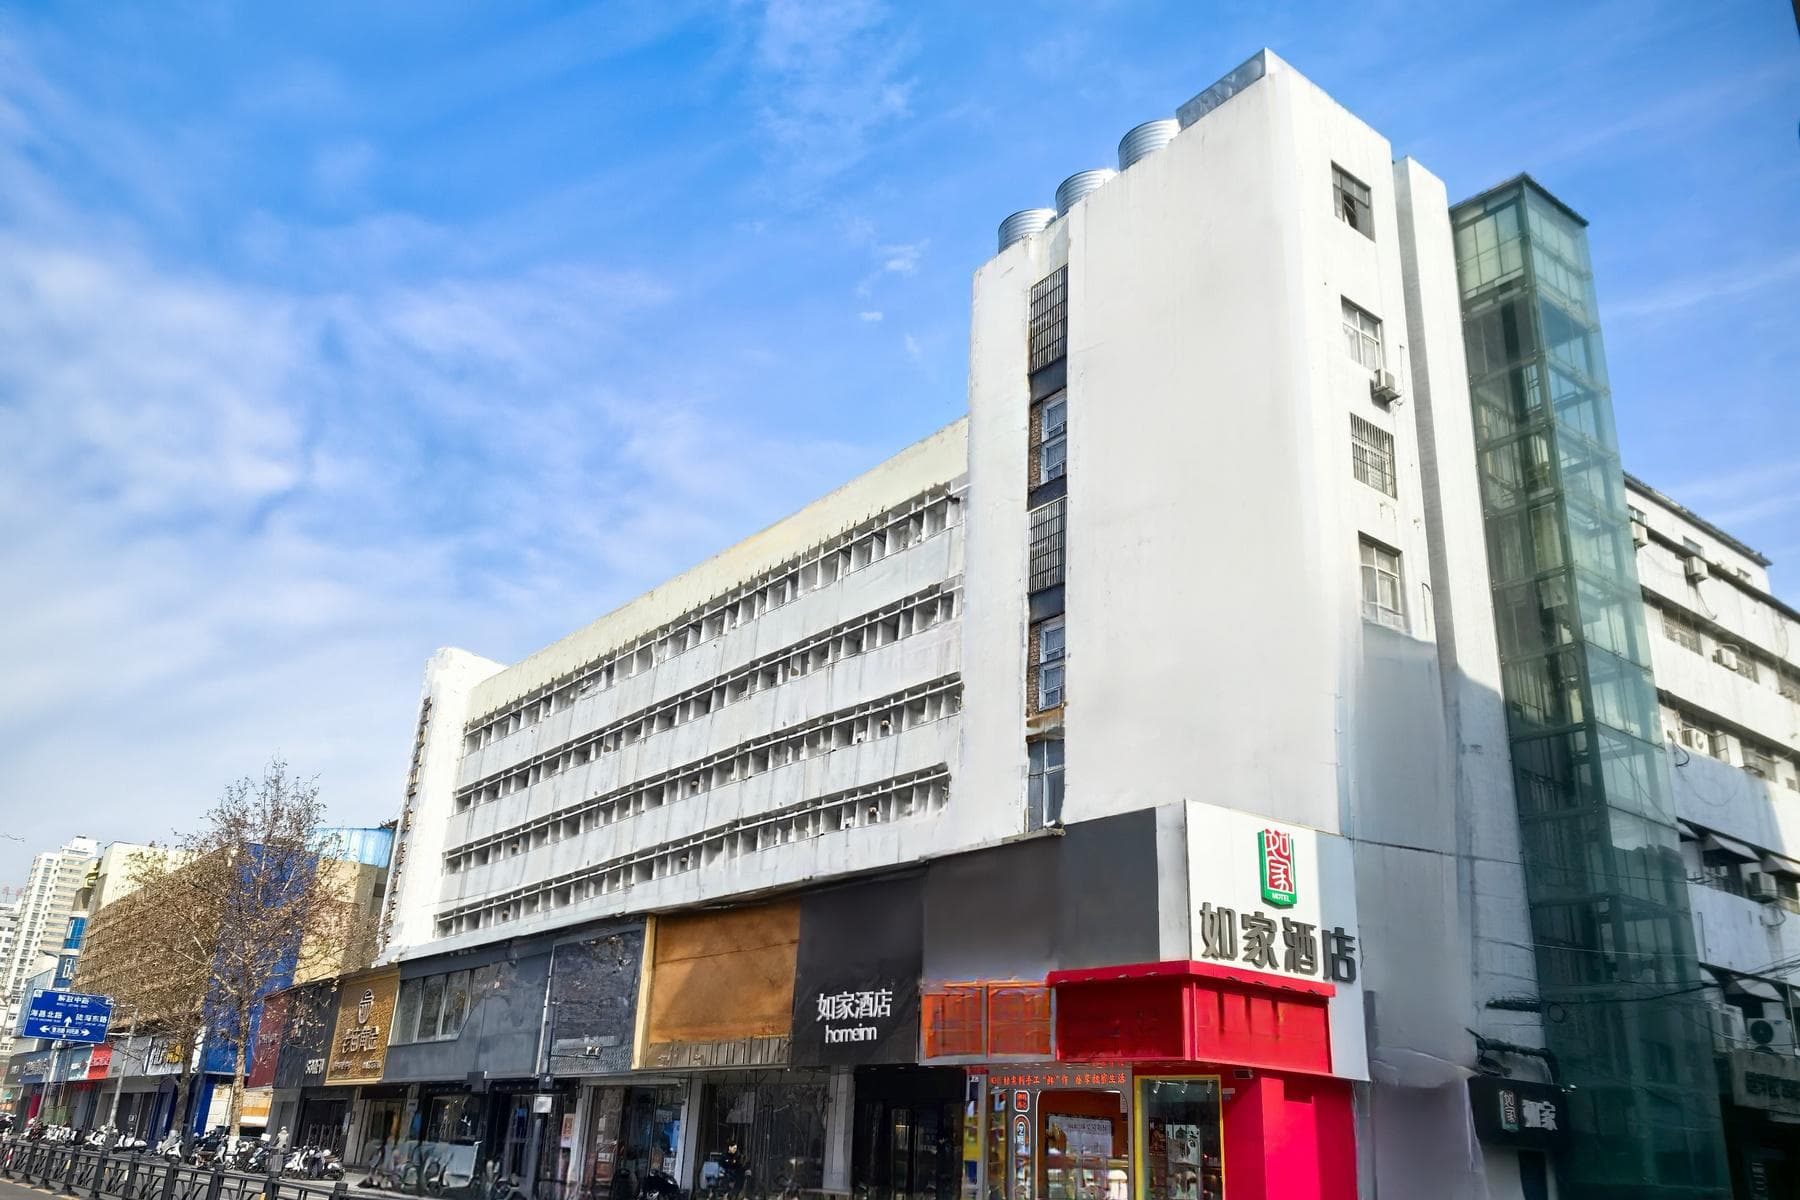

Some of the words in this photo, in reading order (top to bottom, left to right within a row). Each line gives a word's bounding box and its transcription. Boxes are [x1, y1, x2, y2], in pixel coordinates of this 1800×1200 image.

[1199, 902, 1357, 984] 如家酒店
[57, 994, 89, 1005] 解放中路
[816, 988, 893, 1022] 如家酒店
[825, 1023, 877, 1044] homeinn
